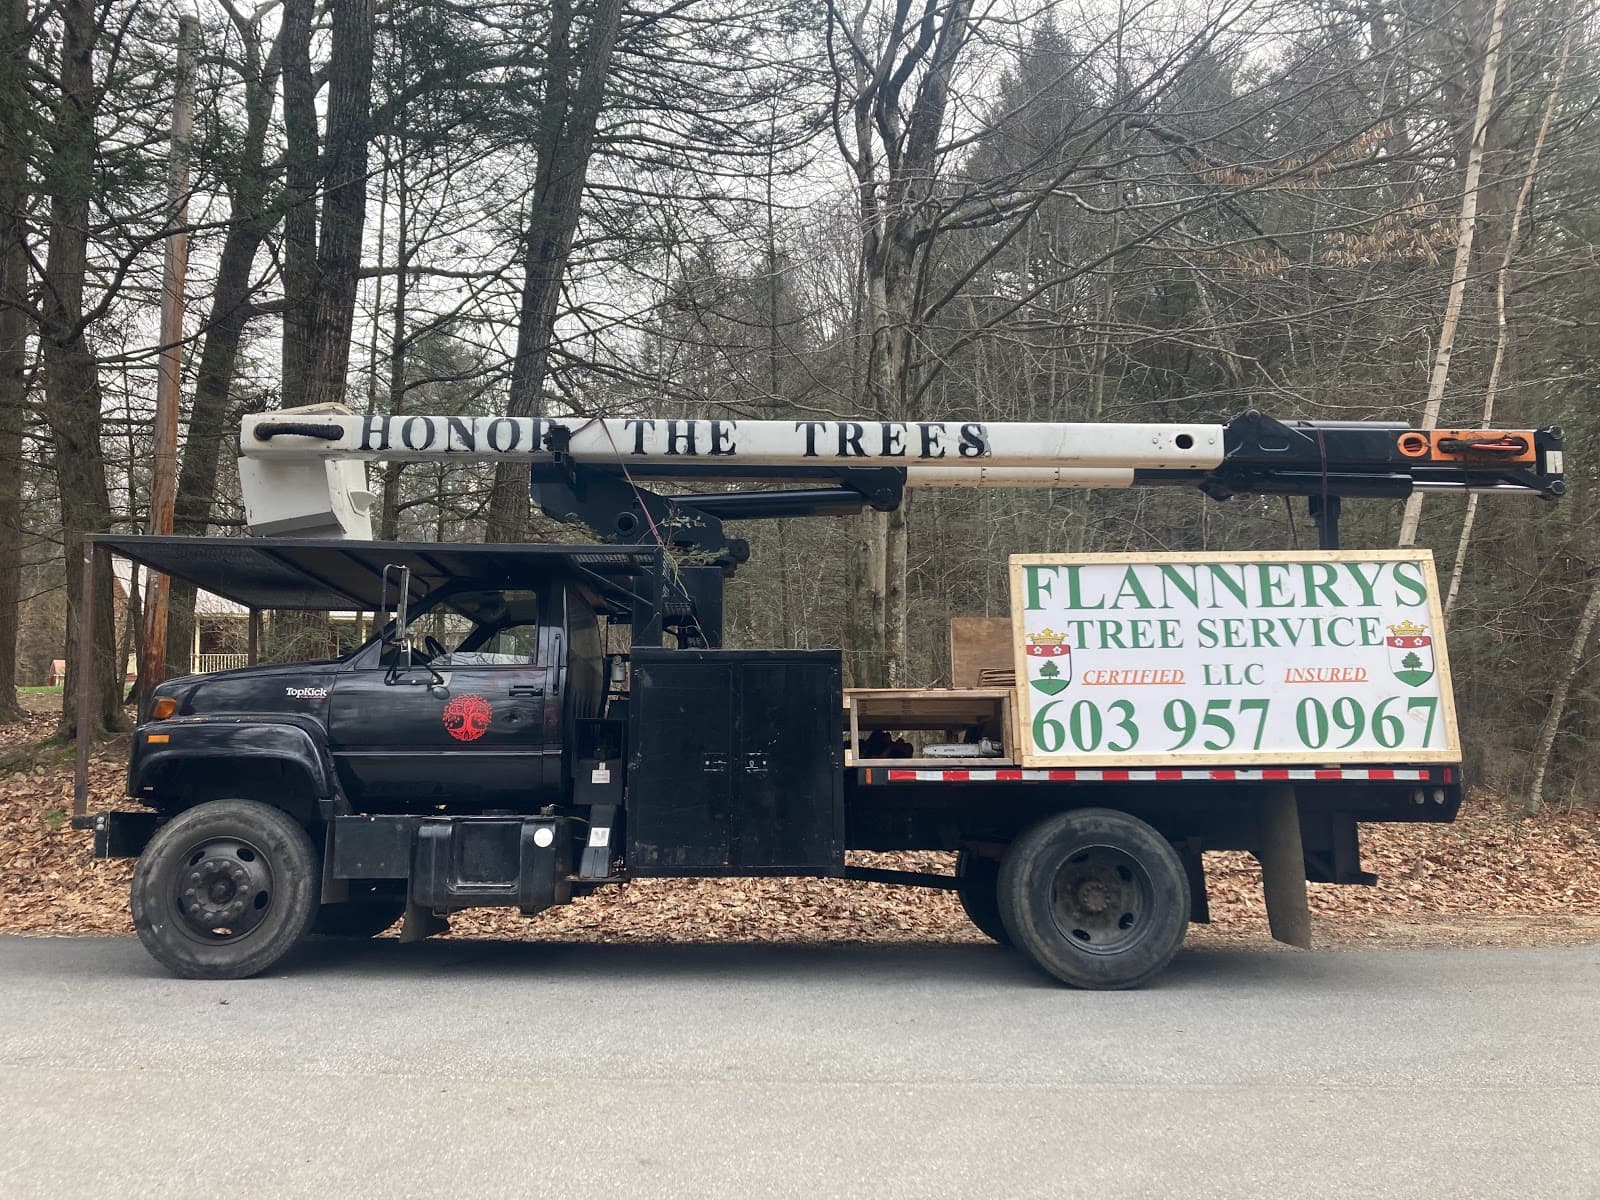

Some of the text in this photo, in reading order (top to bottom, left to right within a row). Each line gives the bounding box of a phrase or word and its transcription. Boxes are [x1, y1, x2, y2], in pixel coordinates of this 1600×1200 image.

[624, 419, 737, 456] THE
[795, 421, 991, 458] TREES
[1023, 562, 1428, 611] FLANNERYS
[1067, 616, 1385, 650] TREE SERVICE
[286, 687, 328, 698] TopKick
[1082, 663, 1368, 686] CERTIFIED LLC INSURED
[1032, 696, 1439, 752] 603 957 0967
